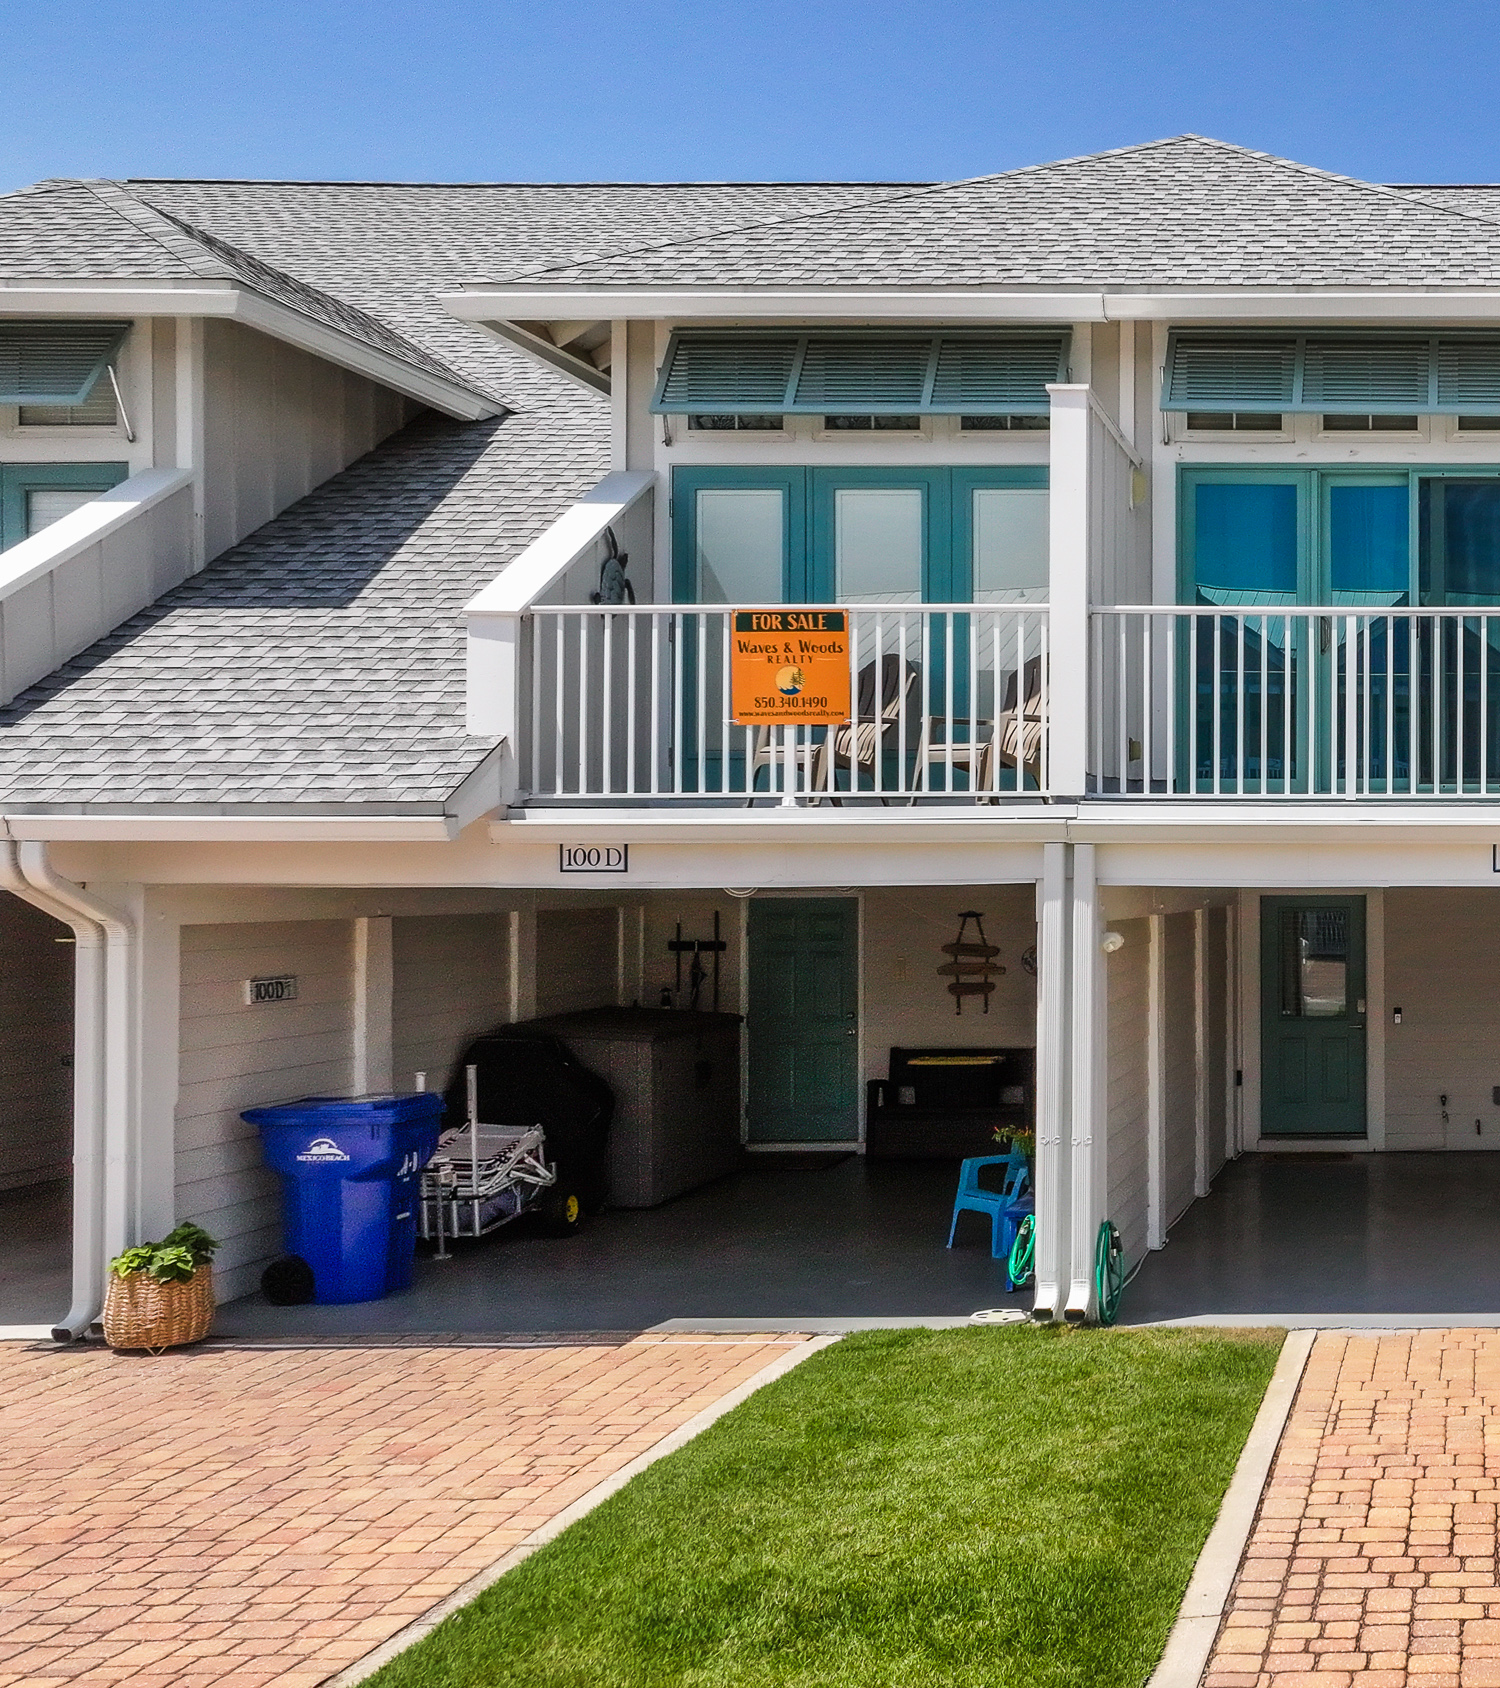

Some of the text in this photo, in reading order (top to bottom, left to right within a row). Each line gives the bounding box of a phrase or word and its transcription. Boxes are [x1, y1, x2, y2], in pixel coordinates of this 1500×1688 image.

[752, 614, 827, 630] FOR SALE
[737, 640, 843, 654] Waves & Woods
[767, 655, 814, 664] REALTY
[754, 696, 828, 708] 850.340.1490
[565, 847, 622, 867] 100 D
